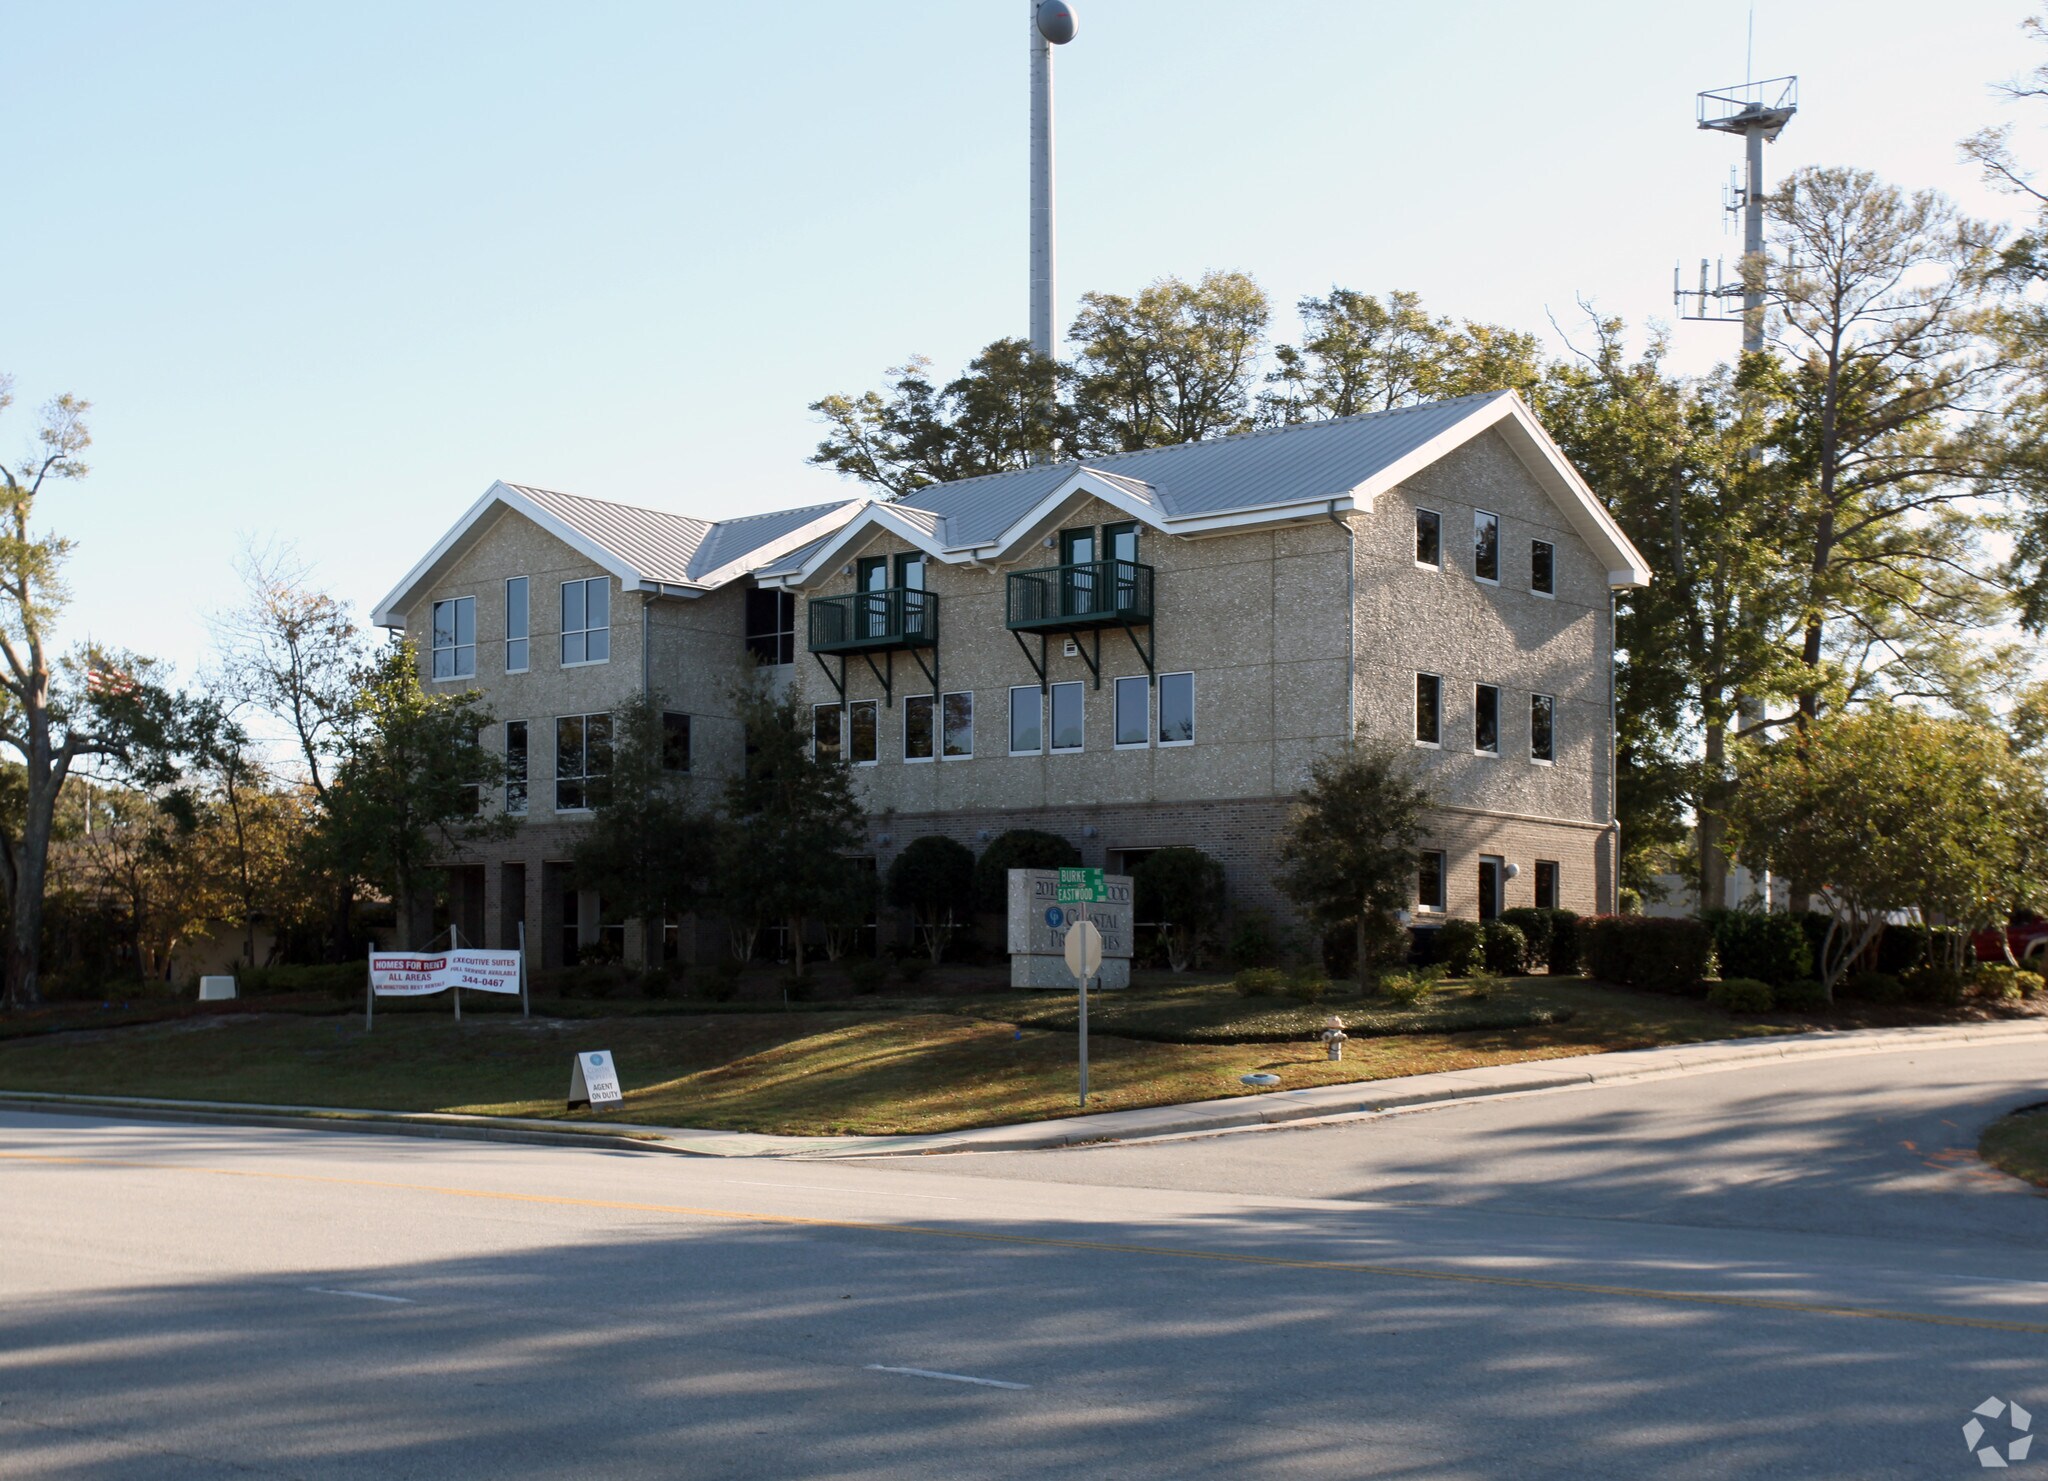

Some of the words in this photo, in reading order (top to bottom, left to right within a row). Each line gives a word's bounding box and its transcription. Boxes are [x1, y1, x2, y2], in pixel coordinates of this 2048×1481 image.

[1061, 870, 1086, 882] BURKE
[1036, 881, 1058, 896] 201
[1058, 888, 1093, 901] EASTWOOD
[376, 960, 404, 969] HOMES
[406, 961, 422, 970] FOR
[423, 960, 444, 970] RENT
[453, 957, 490, 966] EXECUTIVE
[492, 959, 515, 967] SUITES
[464, 967, 487, 975] SERVICE
[389, 973, 402, 981] ALL
[405, 973, 432, 981] AREAS
[462, 975, 504, 987] 344-0467
[593, 1083, 612, 1091] AGENT
[592, 1092, 602, 1100] ON
[602, 1091, 618, 1099] DUTY
